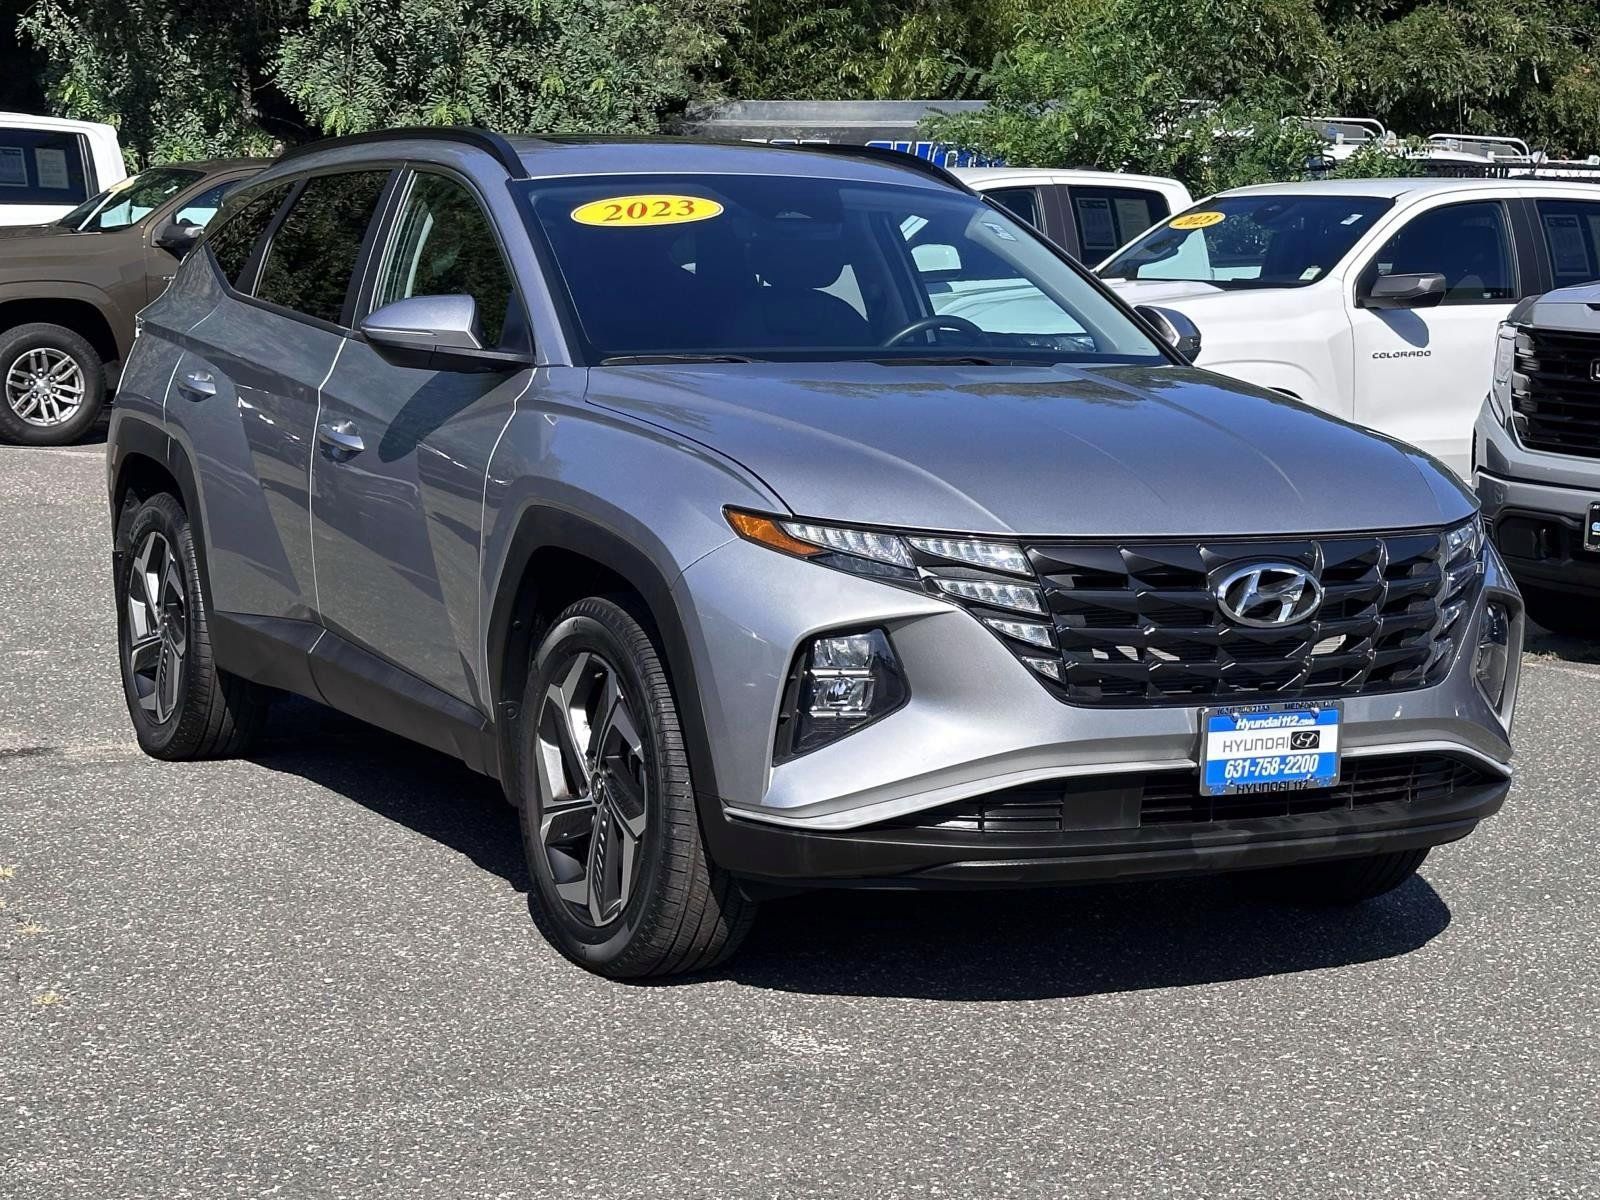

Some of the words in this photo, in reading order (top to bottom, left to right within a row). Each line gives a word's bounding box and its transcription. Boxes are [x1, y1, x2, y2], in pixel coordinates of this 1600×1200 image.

[603, 200, 695, 222] 2023
[1372, 350, 1432, 359] COLORADO
[1235, 715, 1316, 731] Hyundai112.com
[1223, 736, 1289, 753] HYUNDAI
[1224, 754, 1319, 779] 631-758-2200
[1236, 781, 1290, 794] HYUNDAI
